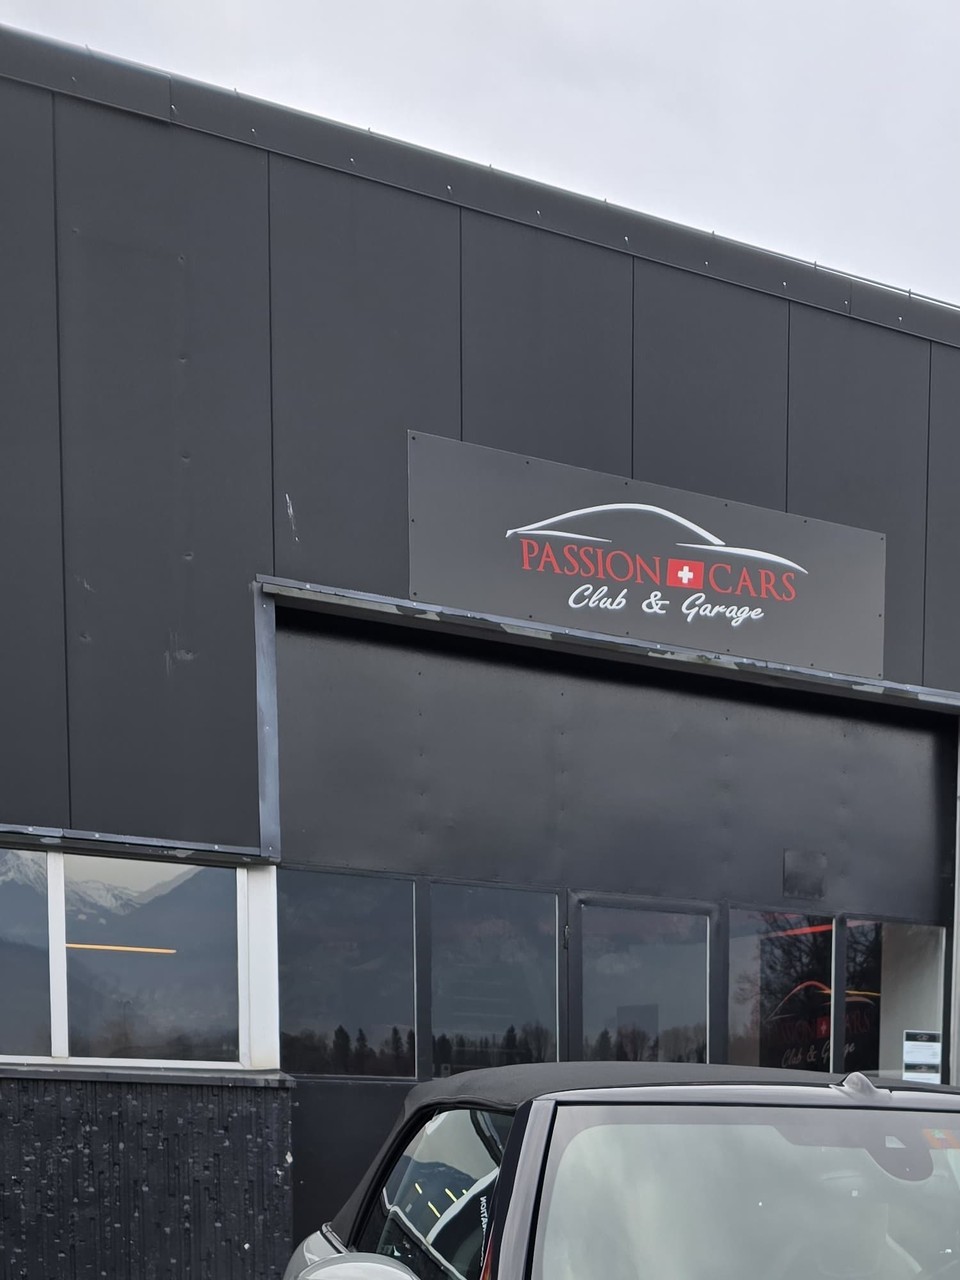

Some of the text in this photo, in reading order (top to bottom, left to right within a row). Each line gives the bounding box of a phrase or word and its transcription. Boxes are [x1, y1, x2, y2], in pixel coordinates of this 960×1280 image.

[520, 538, 798, 602] PASSION CARS
[568, 584, 765, 627] Club & Garage
